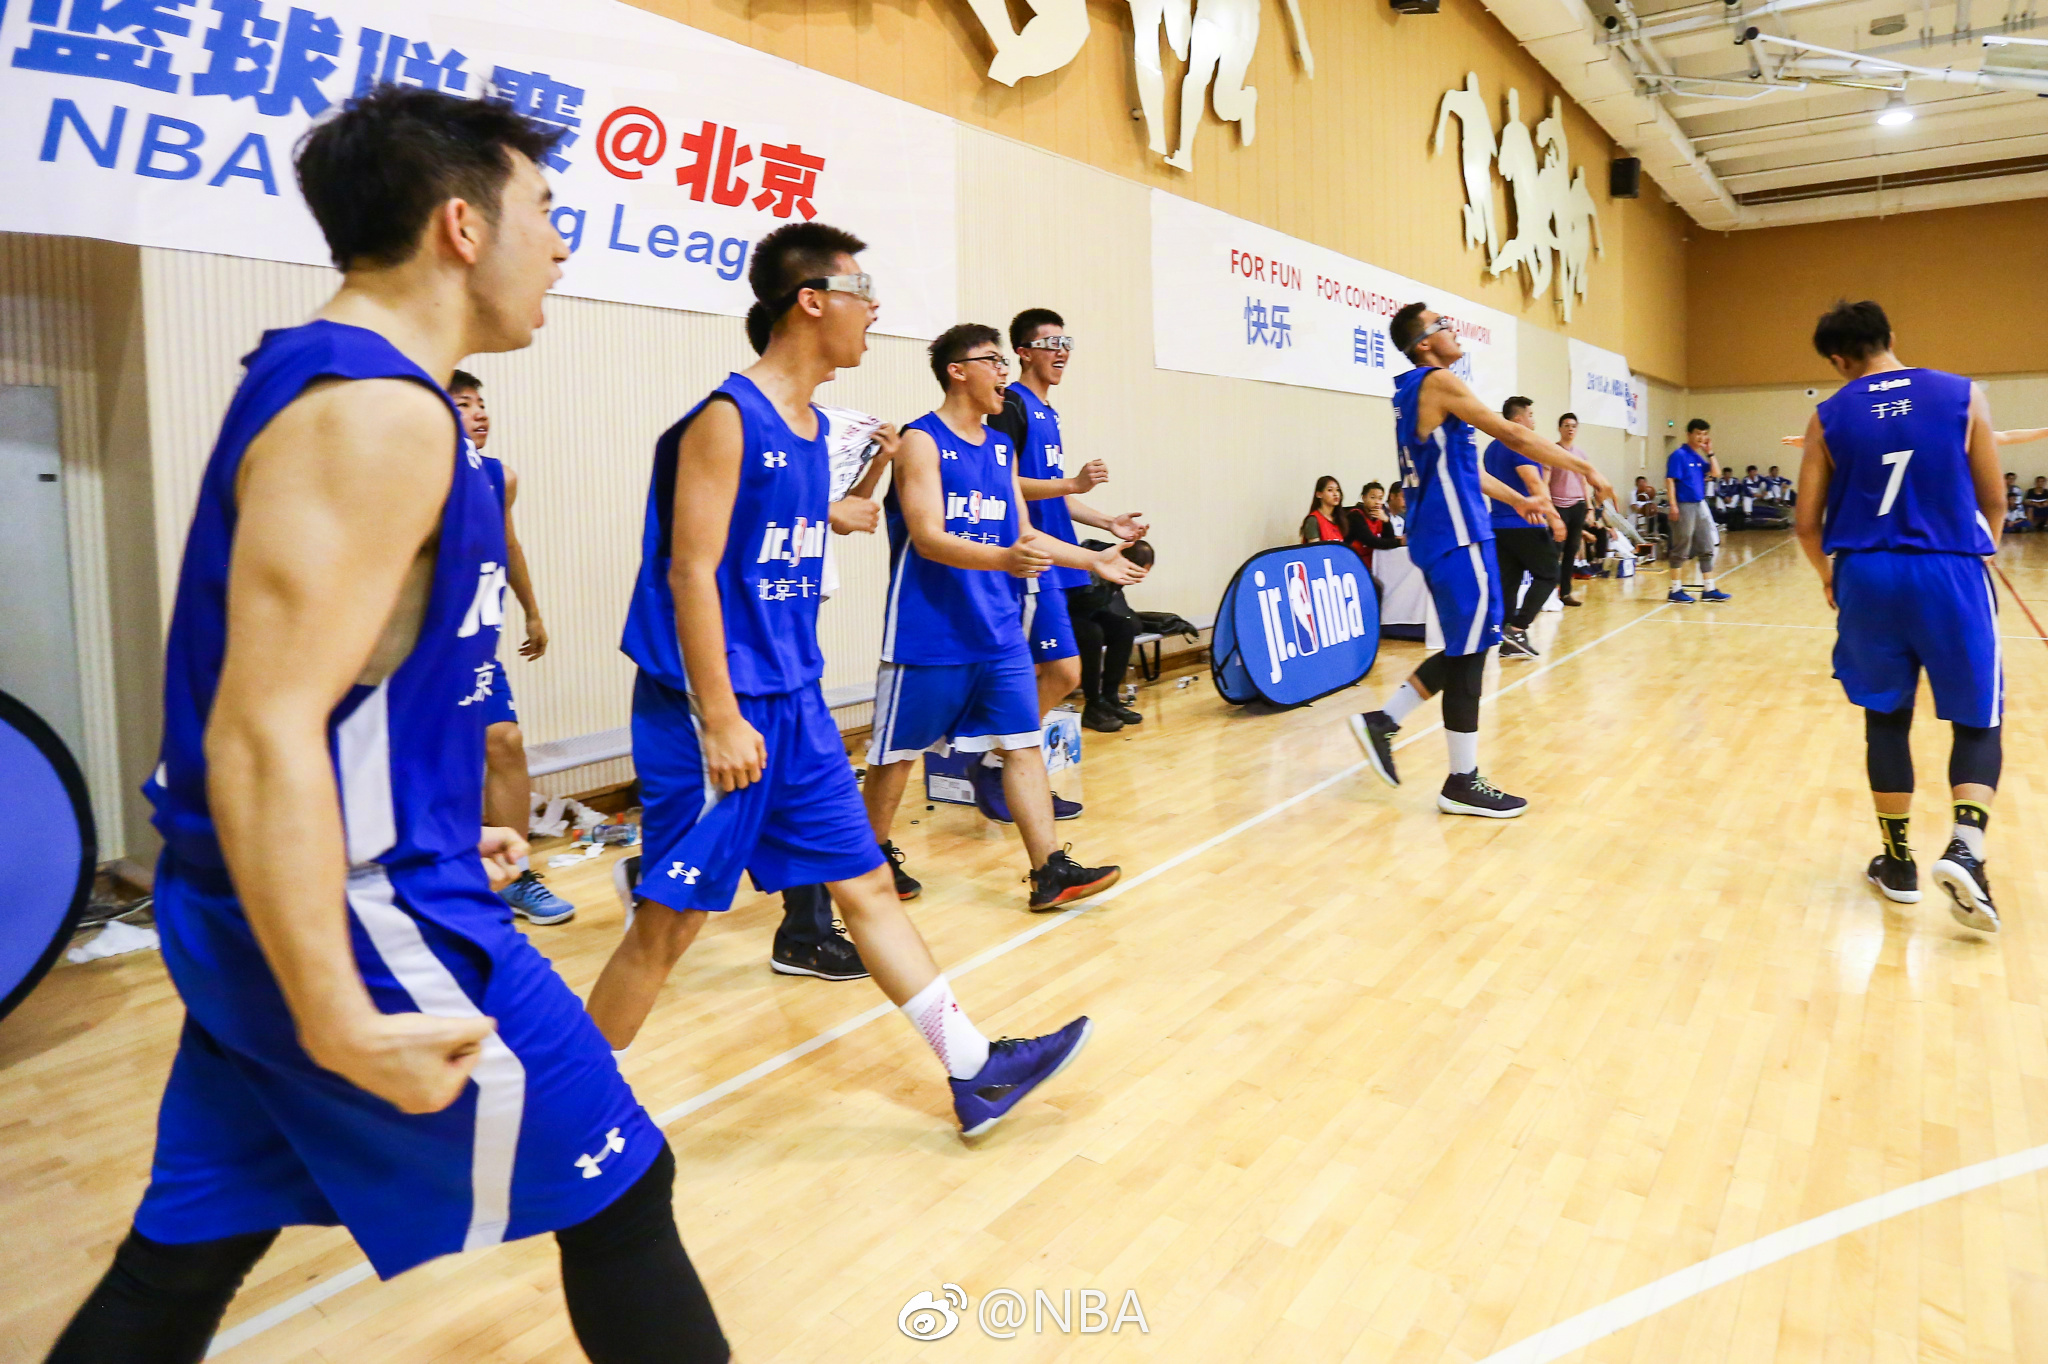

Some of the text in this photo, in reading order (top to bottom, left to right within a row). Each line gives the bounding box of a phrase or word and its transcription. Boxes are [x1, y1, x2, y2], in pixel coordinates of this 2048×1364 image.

[39, 97, 280, 196] NBA
[608, 203, 750, 282] Leag
[1231, 248, 1302, 291] FOR FUN
[1317, 280, 1407, 318] FOR CONFIDEN
[1243, 296, 1292, 349] 快乐
[1354, 325, 1385, 369] 自信
[1871, 398, 1913, 419] 于洋
[1877, 450, 1914, 517] 7
[757, 576, 819, 601] 北京十
[1254, 558, 1366, 684] jr. nba
